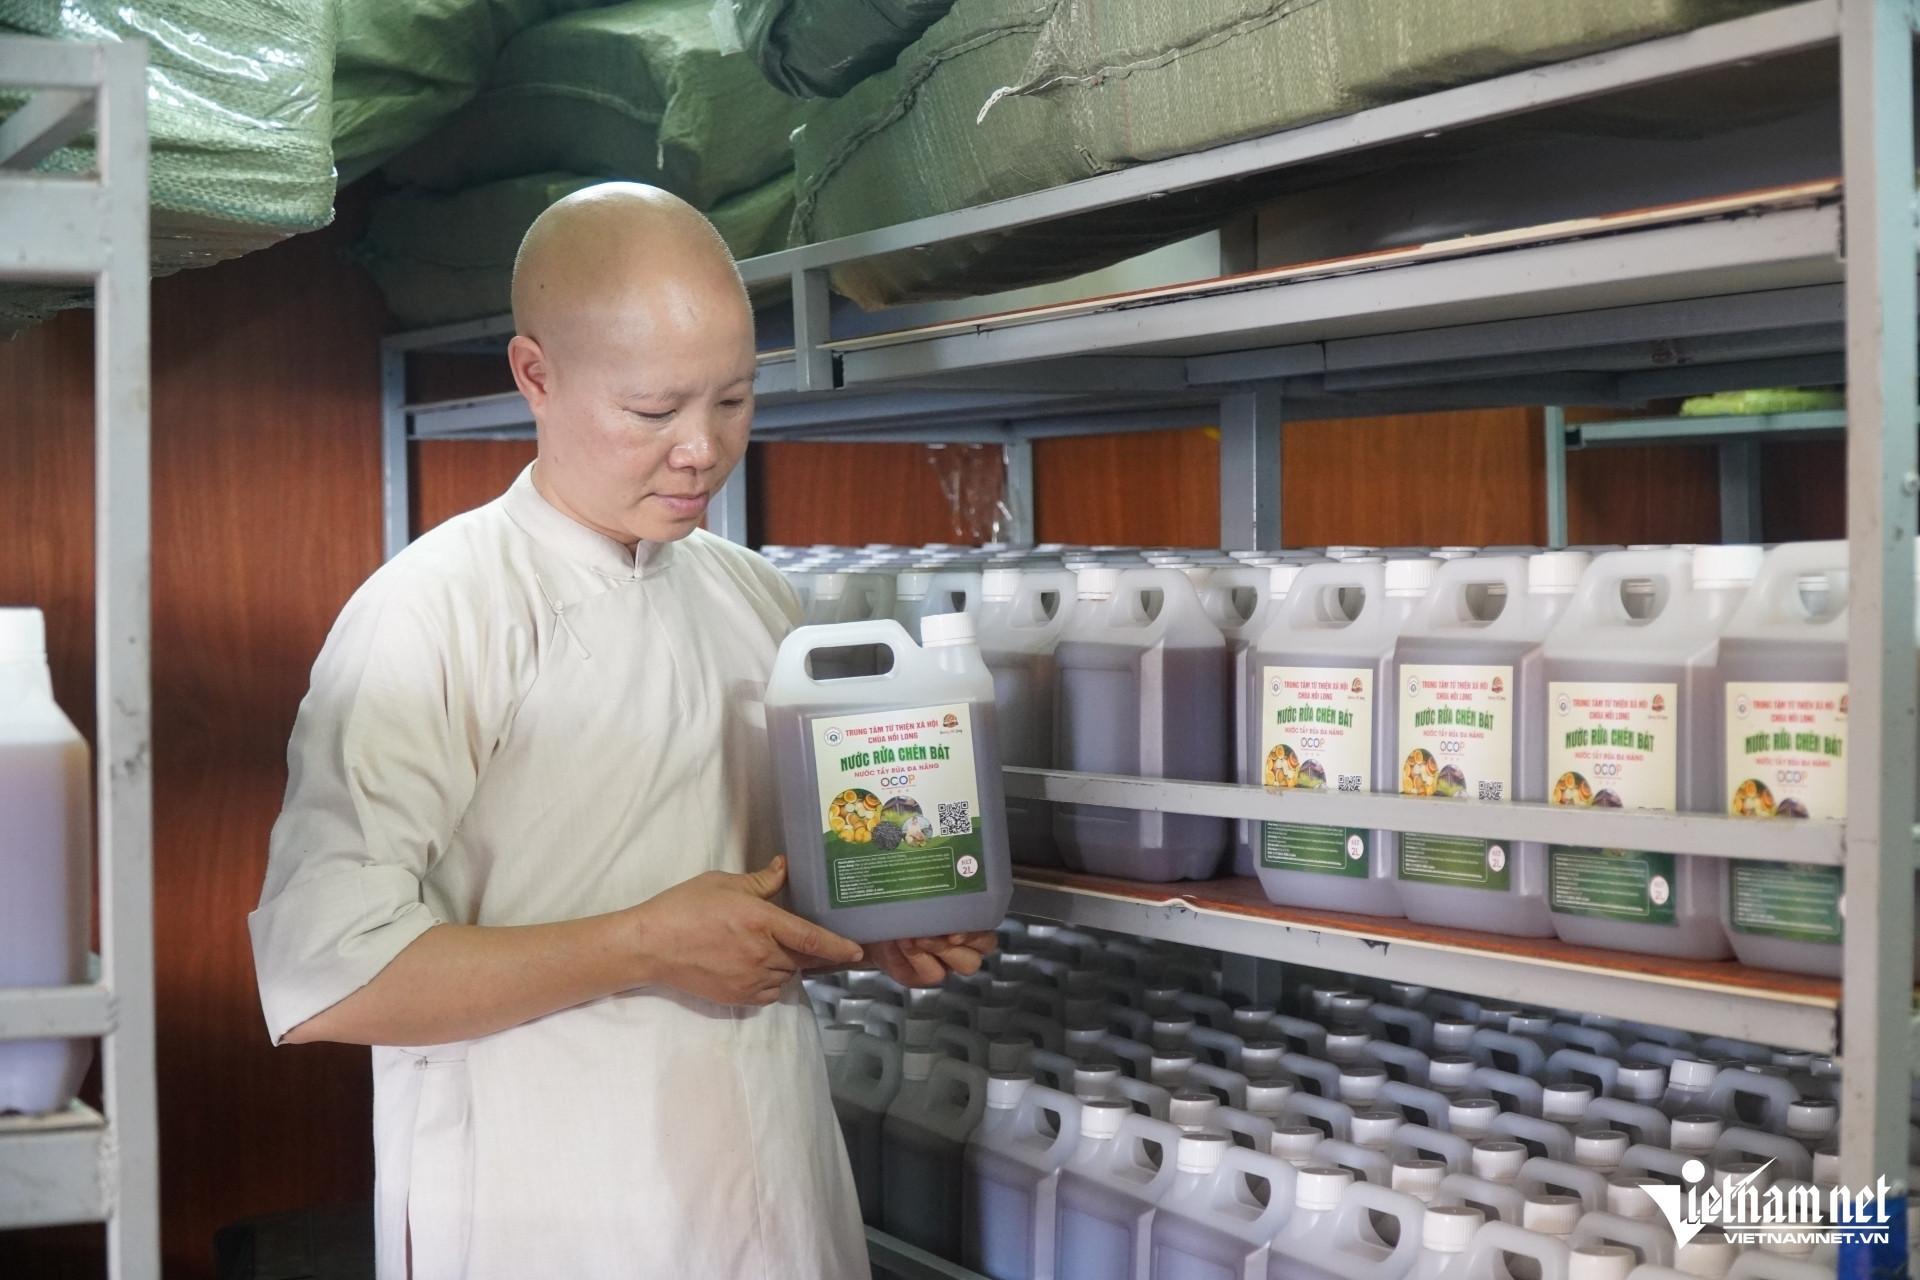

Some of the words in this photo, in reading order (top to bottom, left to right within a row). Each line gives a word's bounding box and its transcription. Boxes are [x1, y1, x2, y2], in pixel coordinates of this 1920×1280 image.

[1277, 706, 1297, 724] NƯỚC
[1299, 703, 1314, 722] RỬA
[1316, 706, 1336, 724] CHÉN
[1338, 708, 1354, 728] BÁT
[1415, 707, 1436, 728] NƯỚC
[1438, 704, 1453, 725] RỬA
[1455, 706, 1476, 726] CHÉN
[1478, 710, 1494, 730] BÁT
[845, 729, 868, 737] TRUNG
[869, 726, 884, 734] TÂM
[886, 724, 894, 732] TỪ
[896, 722, 915, 731] THIỆN
[916, 720, 925, 729] XÃ
[926, 720, 938, 728] HỘI
[868, 736, 886, 744] CHÙA
[888, 734, 899, 742] HỒI
[900, 732, 918, 740] LONG
[1300, 738, 1325, 748] OCOP
[1565, 727, 1588, 749] NƯỚC
[1591, 724, 1608, 746] RỬA
[1611, 727, 1634, 748] CHÉN
[1638, 730, 1654, 752] BÁT
[1440, 741, 1465, 752] OCOP
[840, 751, 870, 772] NƯỚC
[873, 746, 895, 764] RỬA
[898, 744, 927, 761] CHÉN
[930, 744, 950, 760] BÁT
[854, 769, 875, 778] NƯỚC
[877, 766, 890, 775] TẨY
[892, 765, 906, 774] RỬA
[920, 762, 940, 770] NĂNG
[1594, 764, 1622, 775] OCOP
[880, 774, 916, 787] OCOP
[1352, 848, 1360, 856] 2L
[962, 866, 974, 874] 2L
